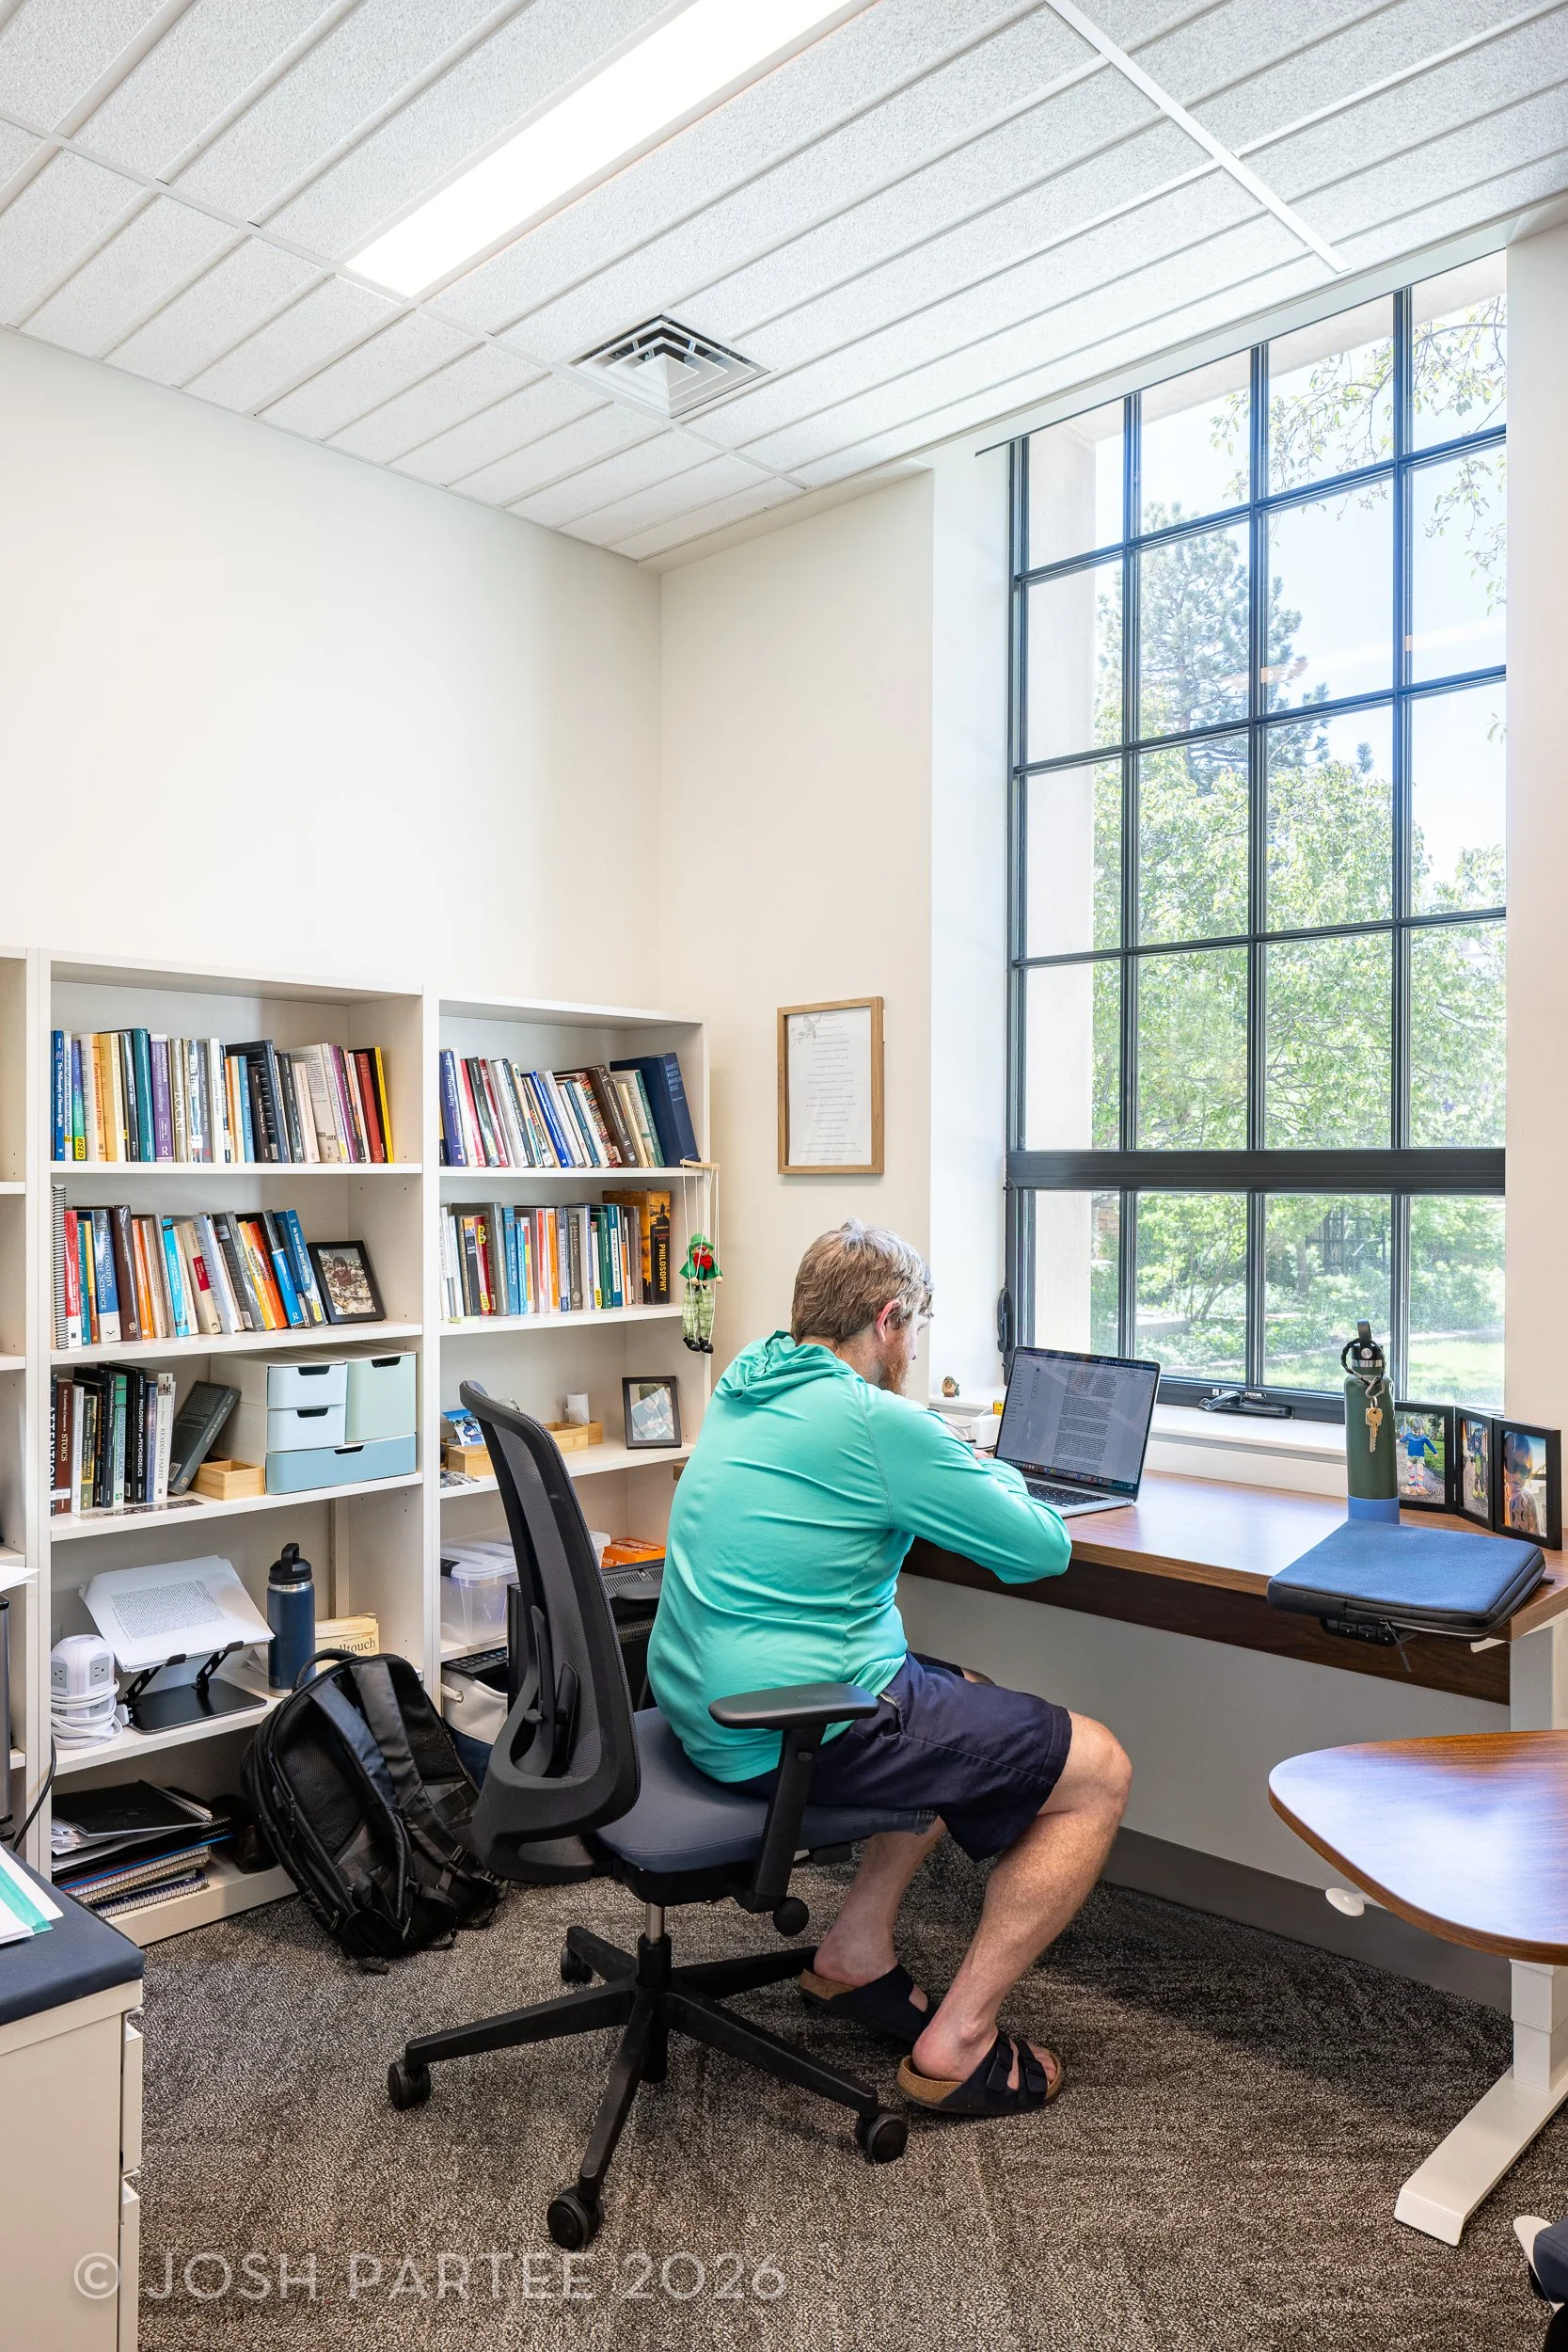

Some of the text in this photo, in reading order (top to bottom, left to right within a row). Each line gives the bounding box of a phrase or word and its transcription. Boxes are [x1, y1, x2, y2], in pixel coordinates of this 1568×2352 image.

[160, 1043, 168, 1083] metaphysics
[447, 1074, 455, 1107] Philosophy
[174, 1091, 184, 1134] LOCKE
[102, 1235, 113, 1288] PHILOSOPHY
[171, 1254, 181, 1290] VAGUENESS
[658, 1244, 667, 1292] PHILOSOPHY
[97, 1260, 107, 1311] OF SCIENCE
